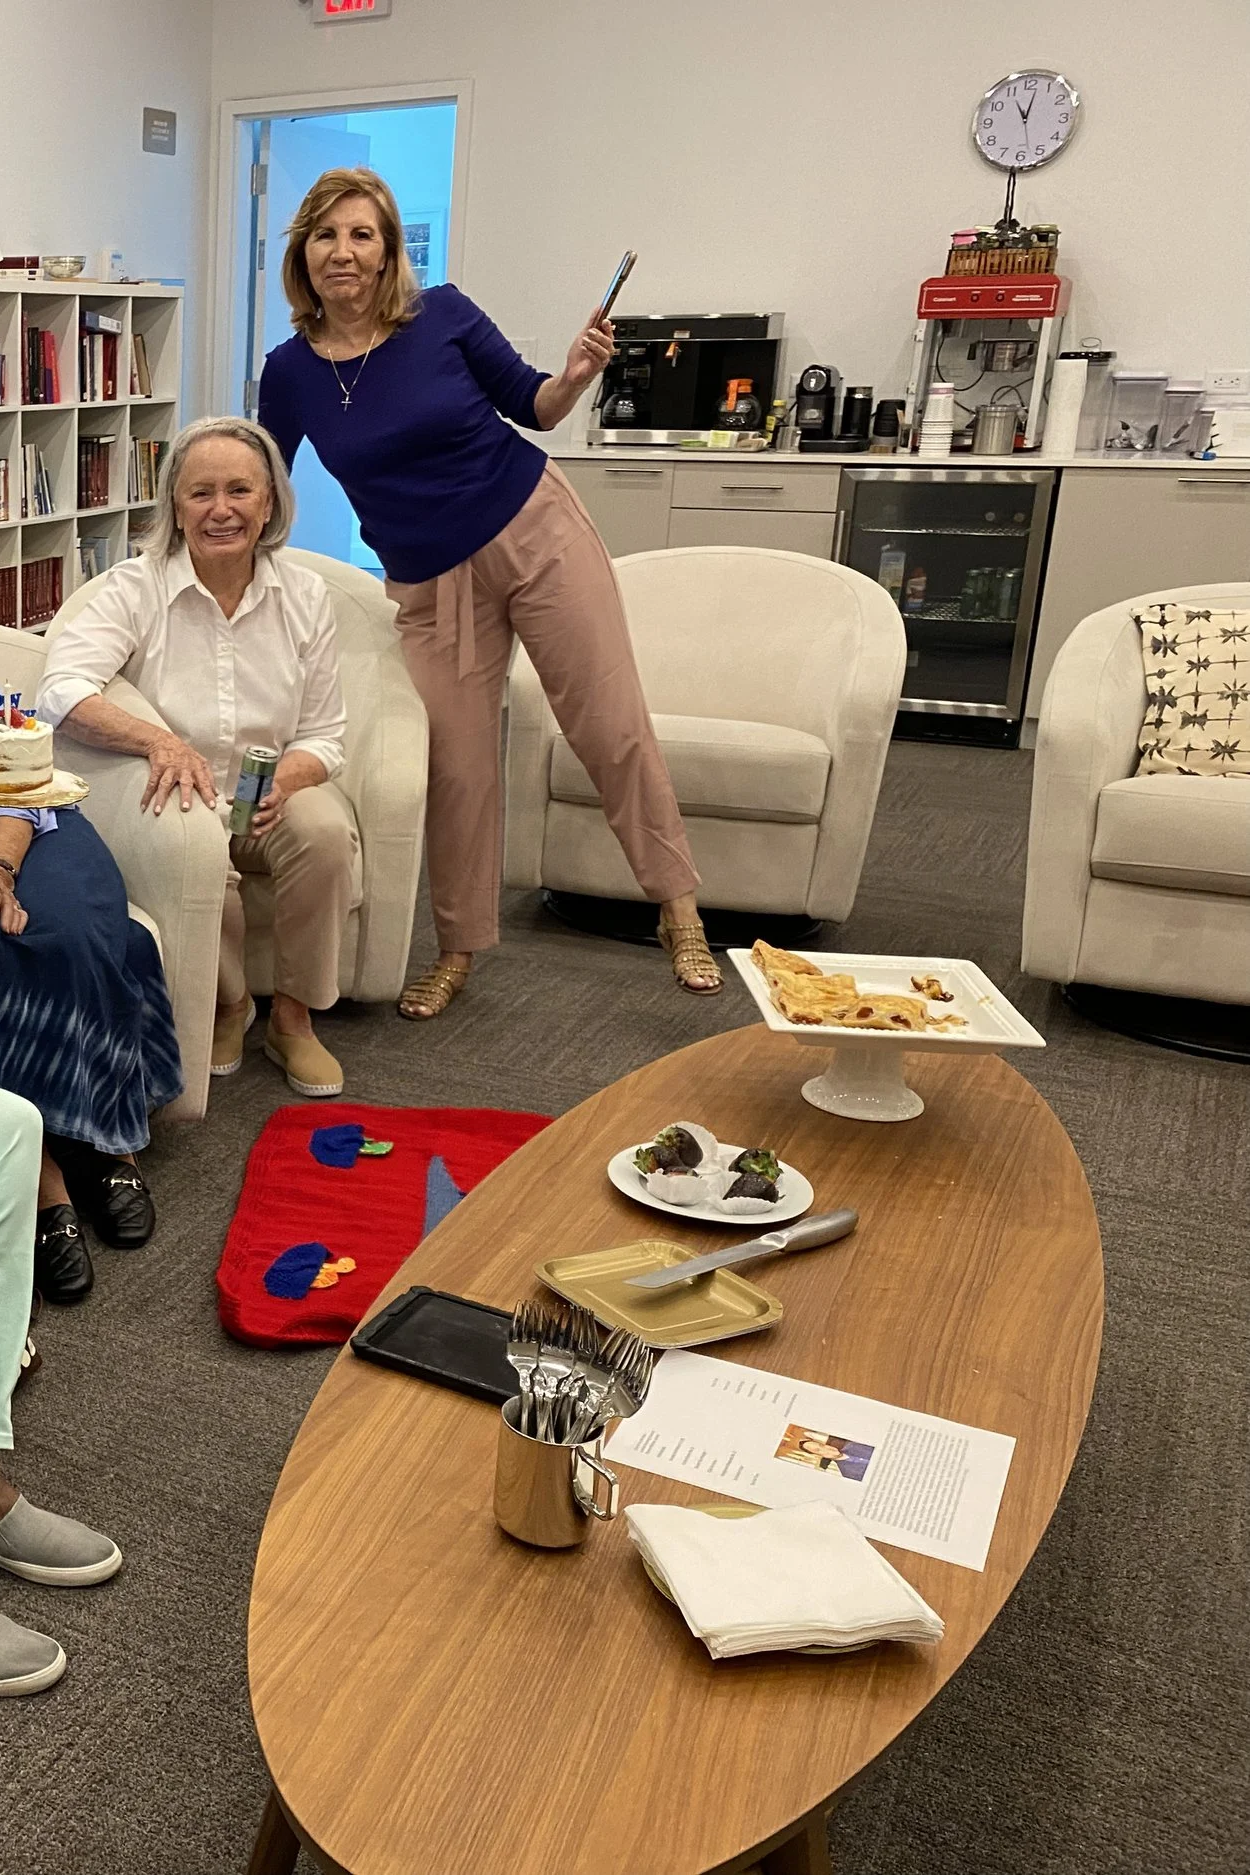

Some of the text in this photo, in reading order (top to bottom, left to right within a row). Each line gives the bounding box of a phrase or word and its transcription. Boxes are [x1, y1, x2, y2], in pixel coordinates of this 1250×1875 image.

[1024, 80, 1037, 90] 12
[1047, 82, 1050, 93] 1
[1006, 87, 1016, 97] 11
[1054, 95, 1065, 105] 2
[991, 101, 1004, 112] 10
[1058, 113, 1069, 123] 3
[983, 118, 993, 129] 9
[986, 135, 996, 146] 8
[1050, 132, 1059, 140] 4
[1000, 148, 1009, 158] 7
[1035, 145, 1045, 155] 5
[1016, 151, 1026, 161] 6
